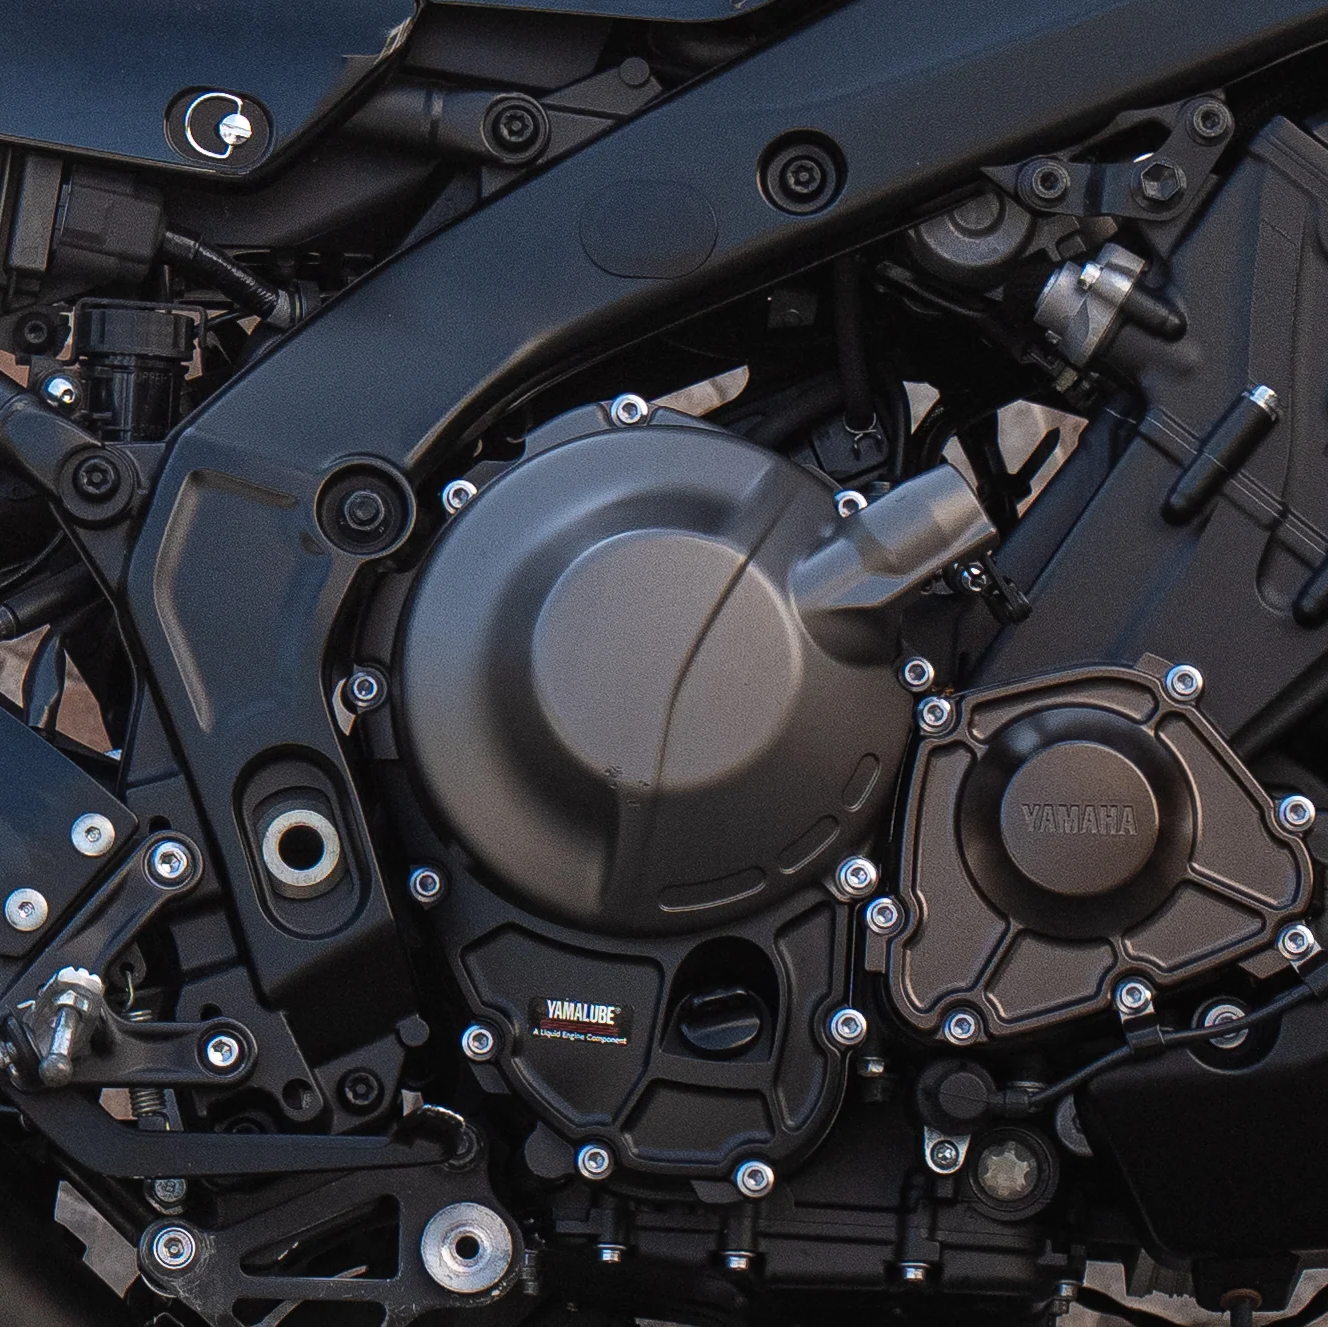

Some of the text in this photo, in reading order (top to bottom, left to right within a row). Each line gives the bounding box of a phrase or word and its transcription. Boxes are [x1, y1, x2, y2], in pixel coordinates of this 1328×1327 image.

[1020, 802, 1139, 837] YAMAHA
[532, 1028, 628, 1045] A Liquid Engine Component
